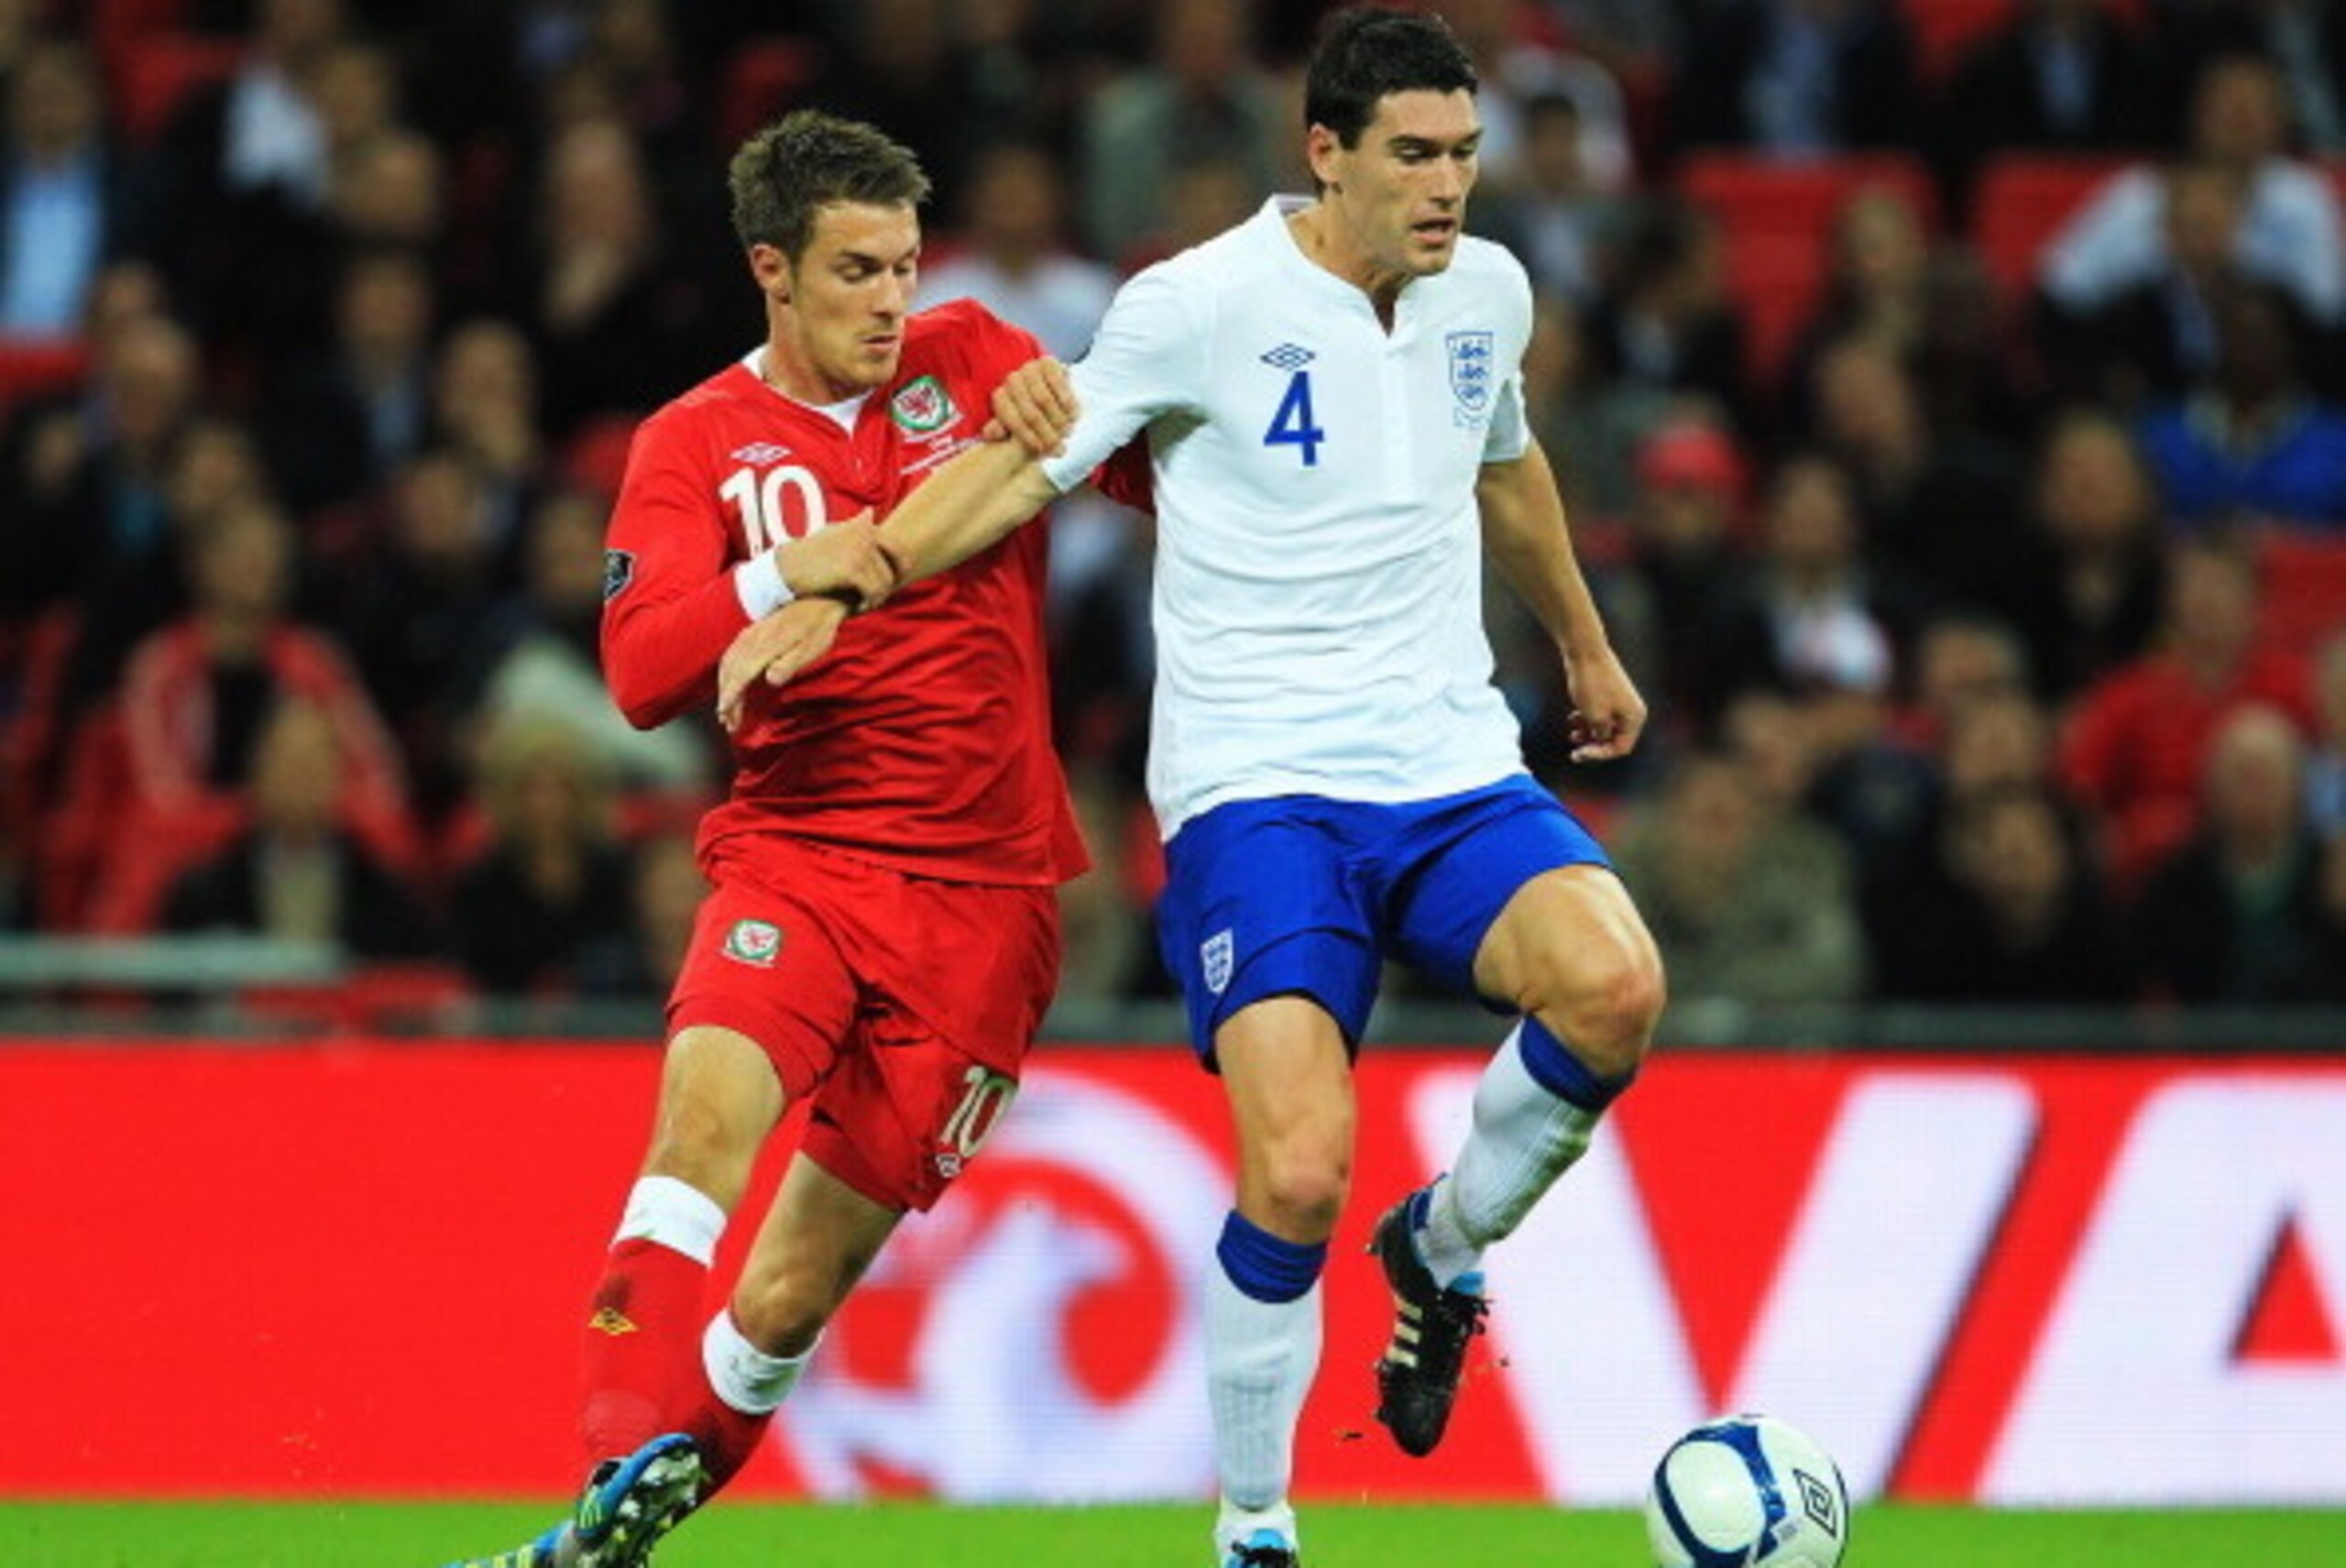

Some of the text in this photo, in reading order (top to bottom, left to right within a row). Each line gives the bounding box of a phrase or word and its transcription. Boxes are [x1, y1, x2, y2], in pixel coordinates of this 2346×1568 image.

[1263, 370, 1325, 466] 4
[718, 465, 827, 559] 10
[939, 1065, 1017, 1157] 10
